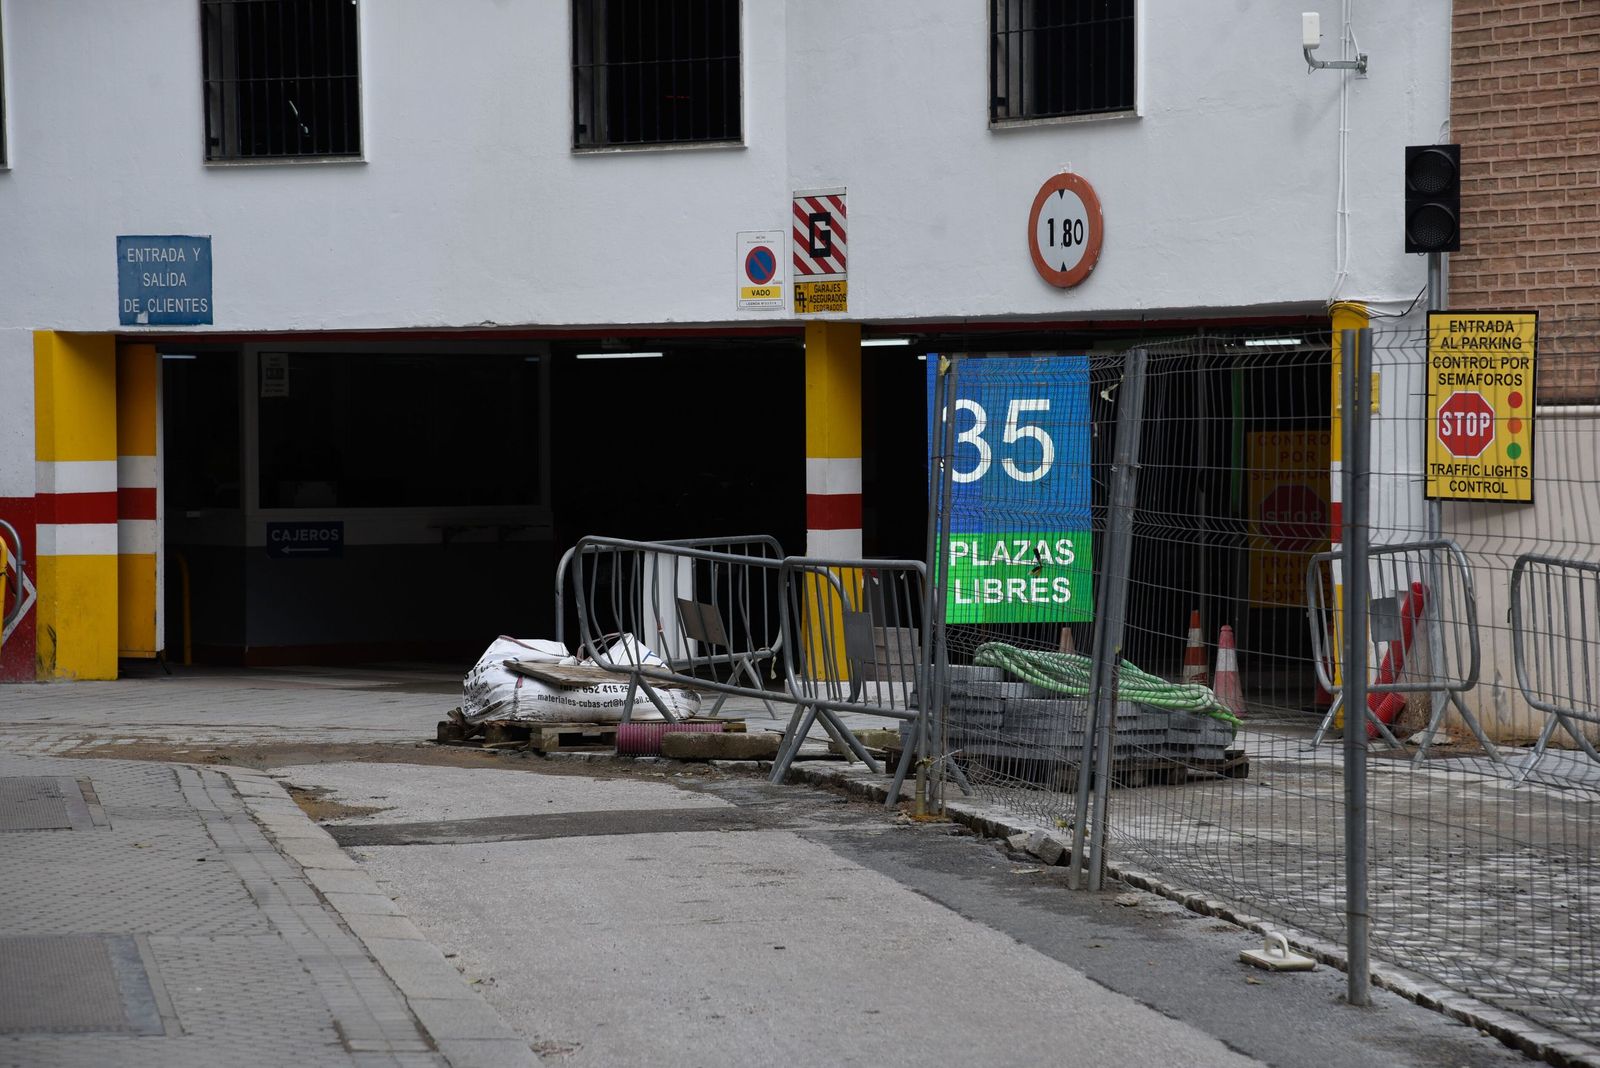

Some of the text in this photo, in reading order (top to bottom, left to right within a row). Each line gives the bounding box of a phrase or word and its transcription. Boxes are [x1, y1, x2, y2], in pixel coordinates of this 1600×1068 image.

[809, 212, 831, 258] G
[127, 247, 201, 262] ENTRADA Y
[143, 272, 187, 287] SALIDA
[813, 283, 842, 293] GARAJES
[124, 298, 208, 312] DE CLIENTES
[809, 293, 847, 303] ASEGURADOS
[1449, 320, 1514, 333] ENTRADA
[1440, 336, 1522, 349] AL PARKING
[1432, 356, 1530, 369] CONTROL POR
[1438, 370, 1523, 386] SEMÁFOROS
[1441, 411, 1491, 437] STOP
[941, 398, 1055, 483] 35
[1258, 433, 1331, 447] CONTRO
[1280, 450, 1316, 463] POR
[1429, 463, 1529, 478] TRAFFIC LIGHTS
[1449, 480, 1508, 494] CONTROL
[1265, 510, 1323, 525] STOP
[271, 528, 339, 542] CAJEROS
[950, 539, 1075, 567] PLAZAS
[954, 577, 1071, 604] LIBRES
[582, 685, 600, 694] 652
[602, 684, 619, 693] 415
